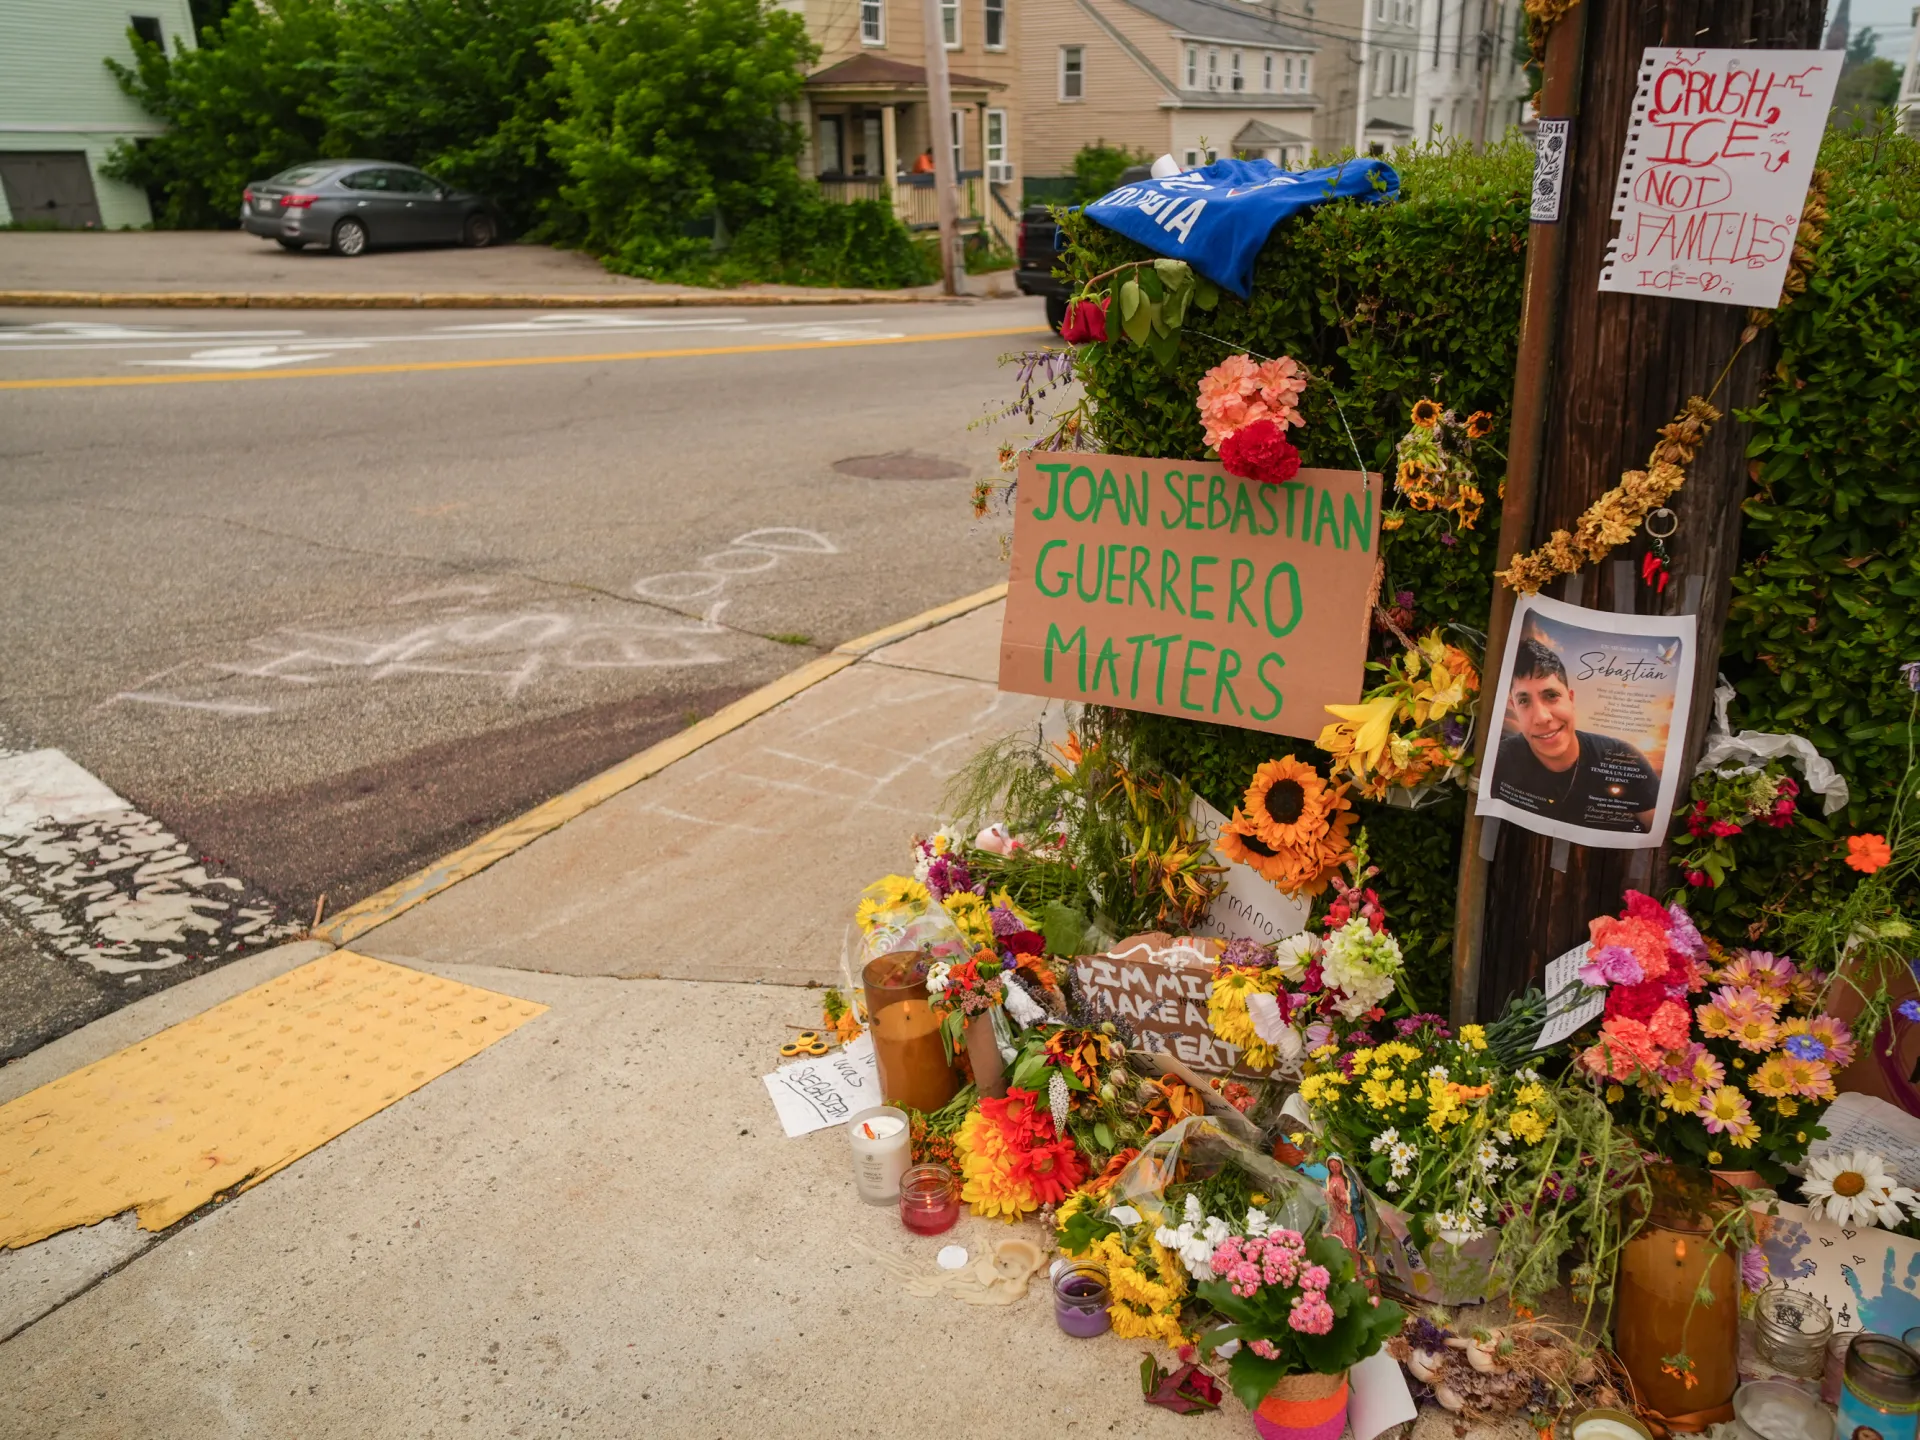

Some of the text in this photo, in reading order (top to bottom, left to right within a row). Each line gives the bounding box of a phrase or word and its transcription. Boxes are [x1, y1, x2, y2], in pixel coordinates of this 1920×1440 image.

[1654, 68, 1775, 117] CRUSH
[1647, 118, 1768, 168] ICE
[1645, 169, 1720, 208] NOT
[1032, 463, 1373, 552] JOAN SEBASTIAN
[1034, 540, 1303, 638] GUERRERO
[1043, 622, 1286, 721] MATTERS
[1577, 651, 1667, 681] Sebastián
